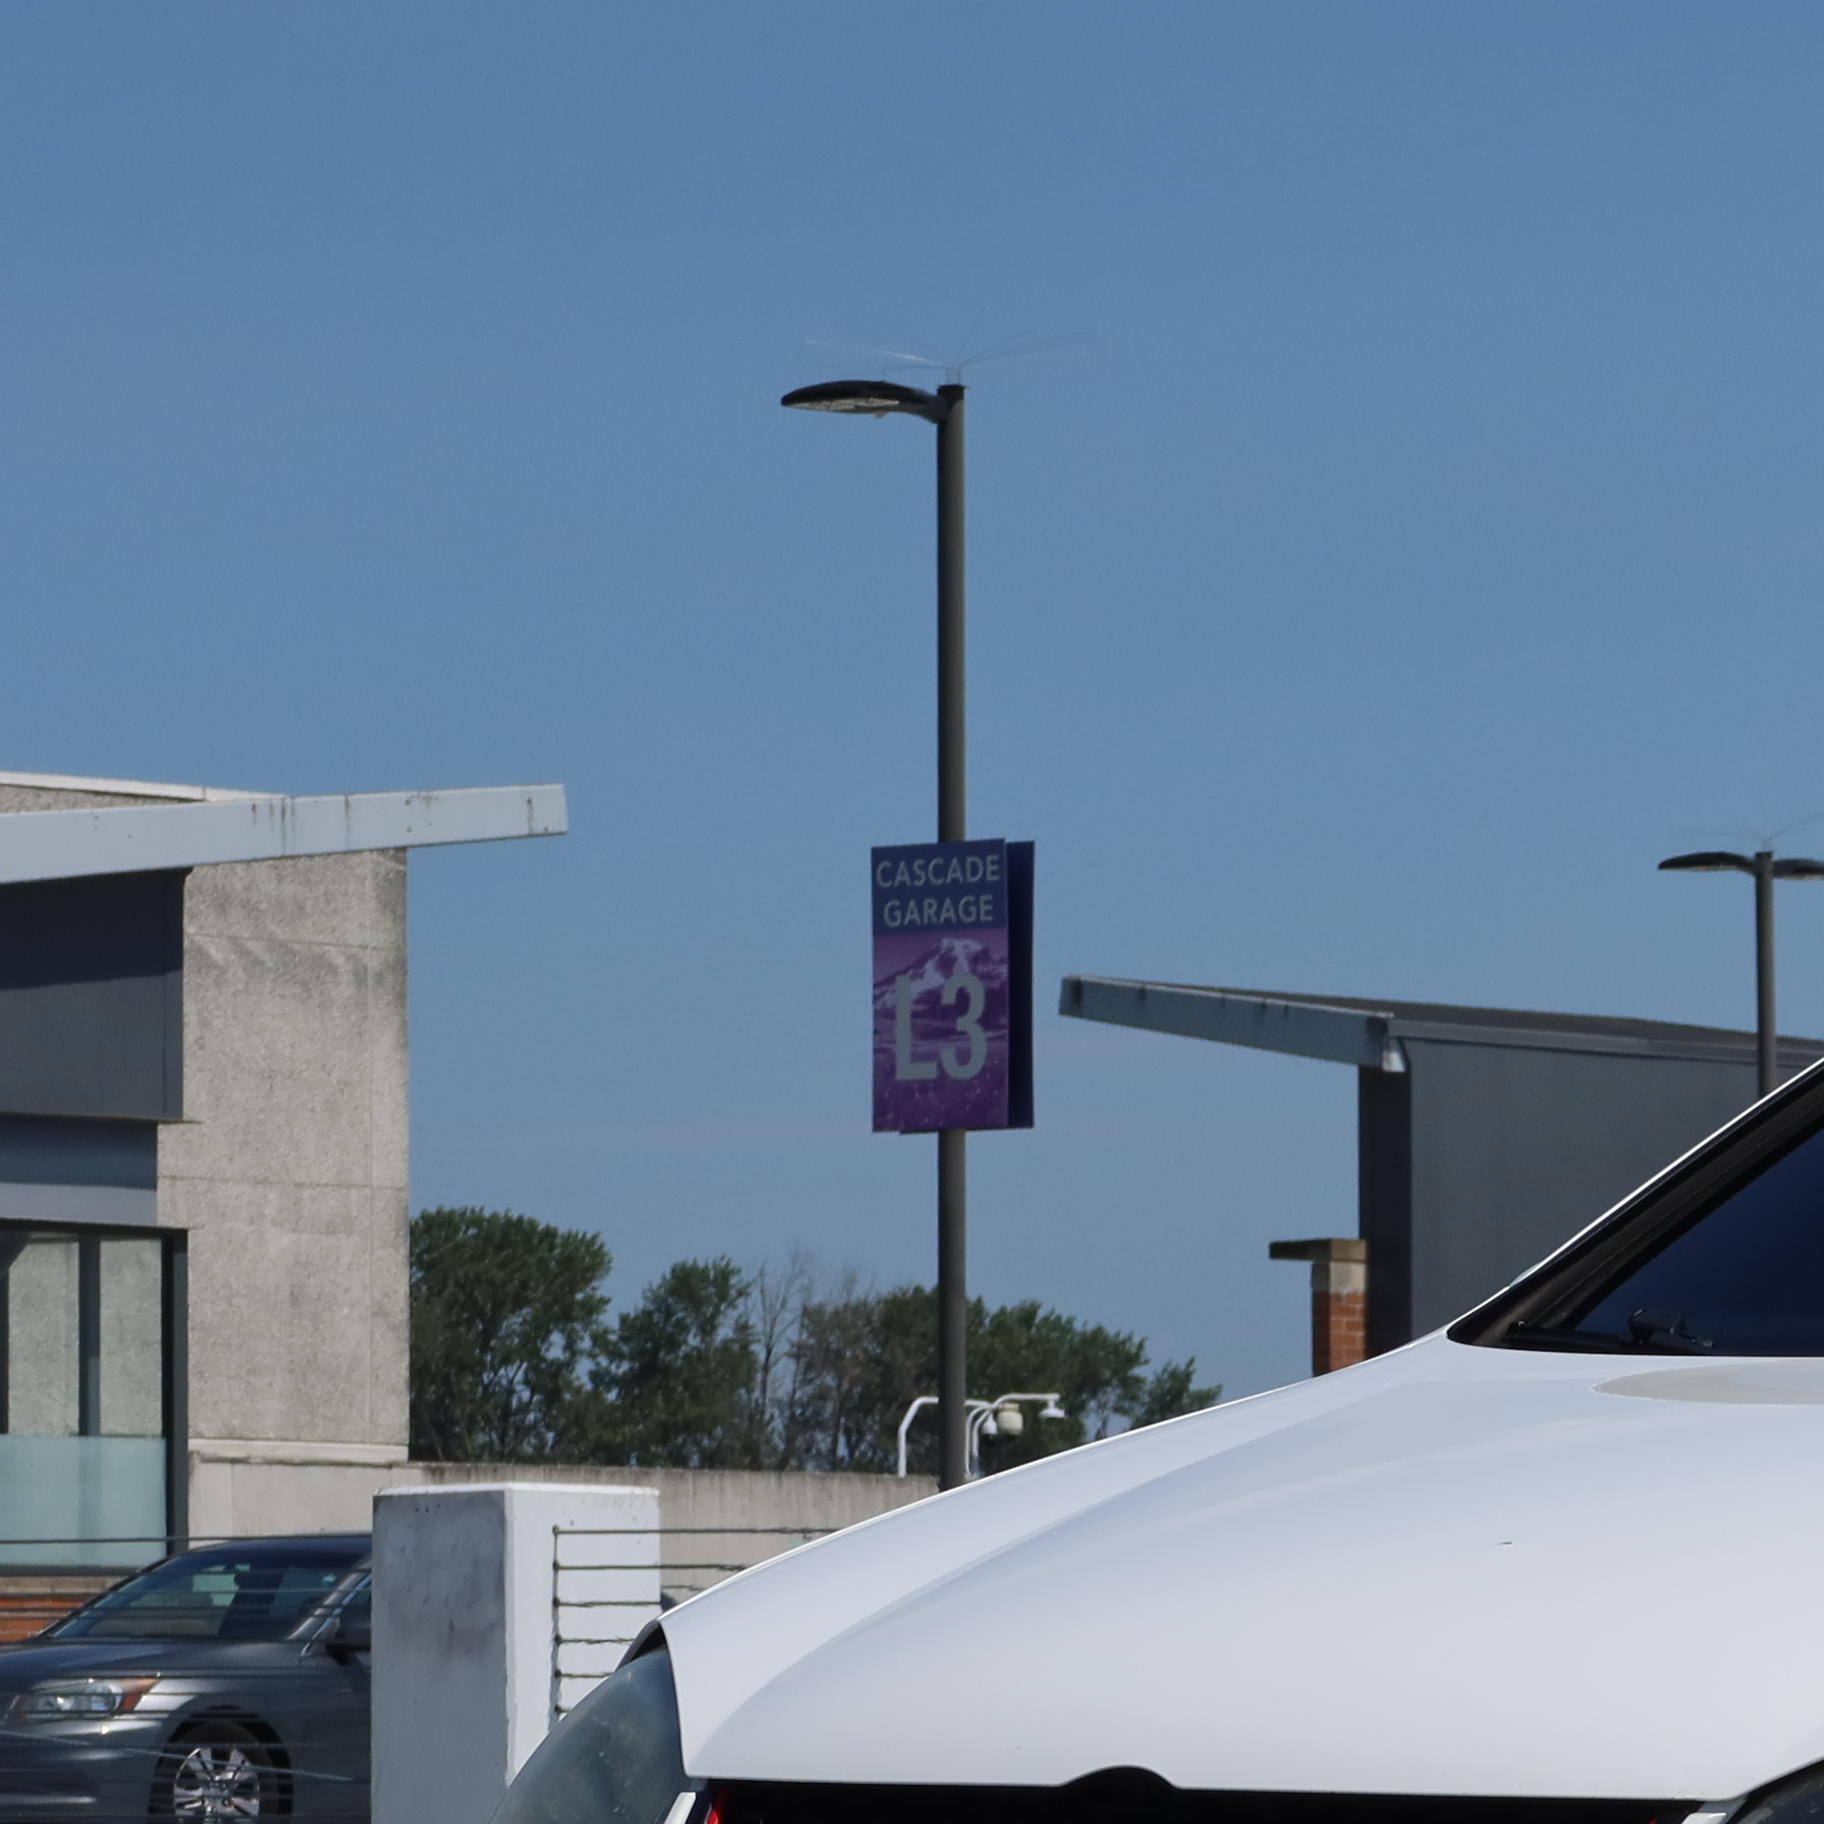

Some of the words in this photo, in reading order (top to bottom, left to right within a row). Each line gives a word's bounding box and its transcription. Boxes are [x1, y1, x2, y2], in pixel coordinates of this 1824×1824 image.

[875, 854, 1000, 888] CASCADE
[883, 894, 994, 927] GARAGE
[894, 971, 988, 1081] L3
